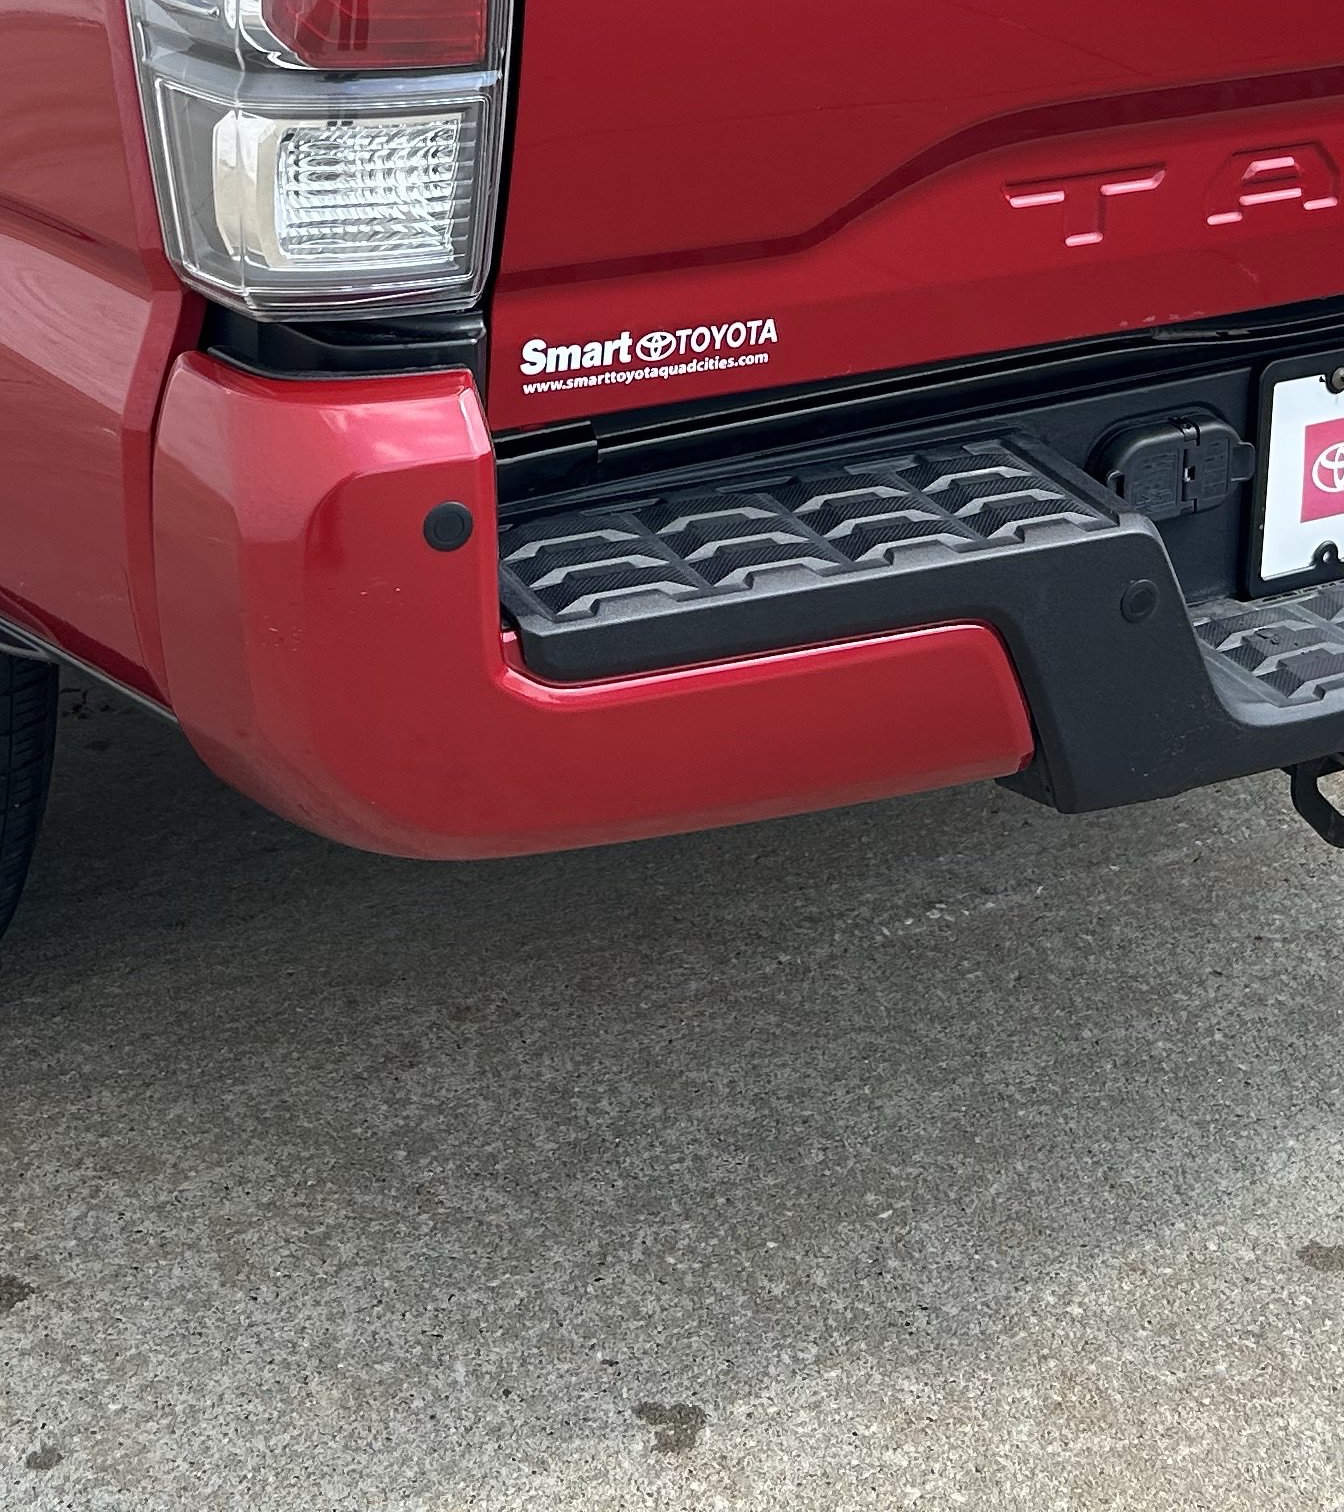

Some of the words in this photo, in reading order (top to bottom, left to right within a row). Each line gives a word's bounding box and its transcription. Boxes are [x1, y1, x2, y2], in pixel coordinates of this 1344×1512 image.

[520, 330, 633, 376] Smart
[674, 317, 779, 355] TOYOTA
[522, 352, 770, 395] www.smarttoyotaquadcities.com
